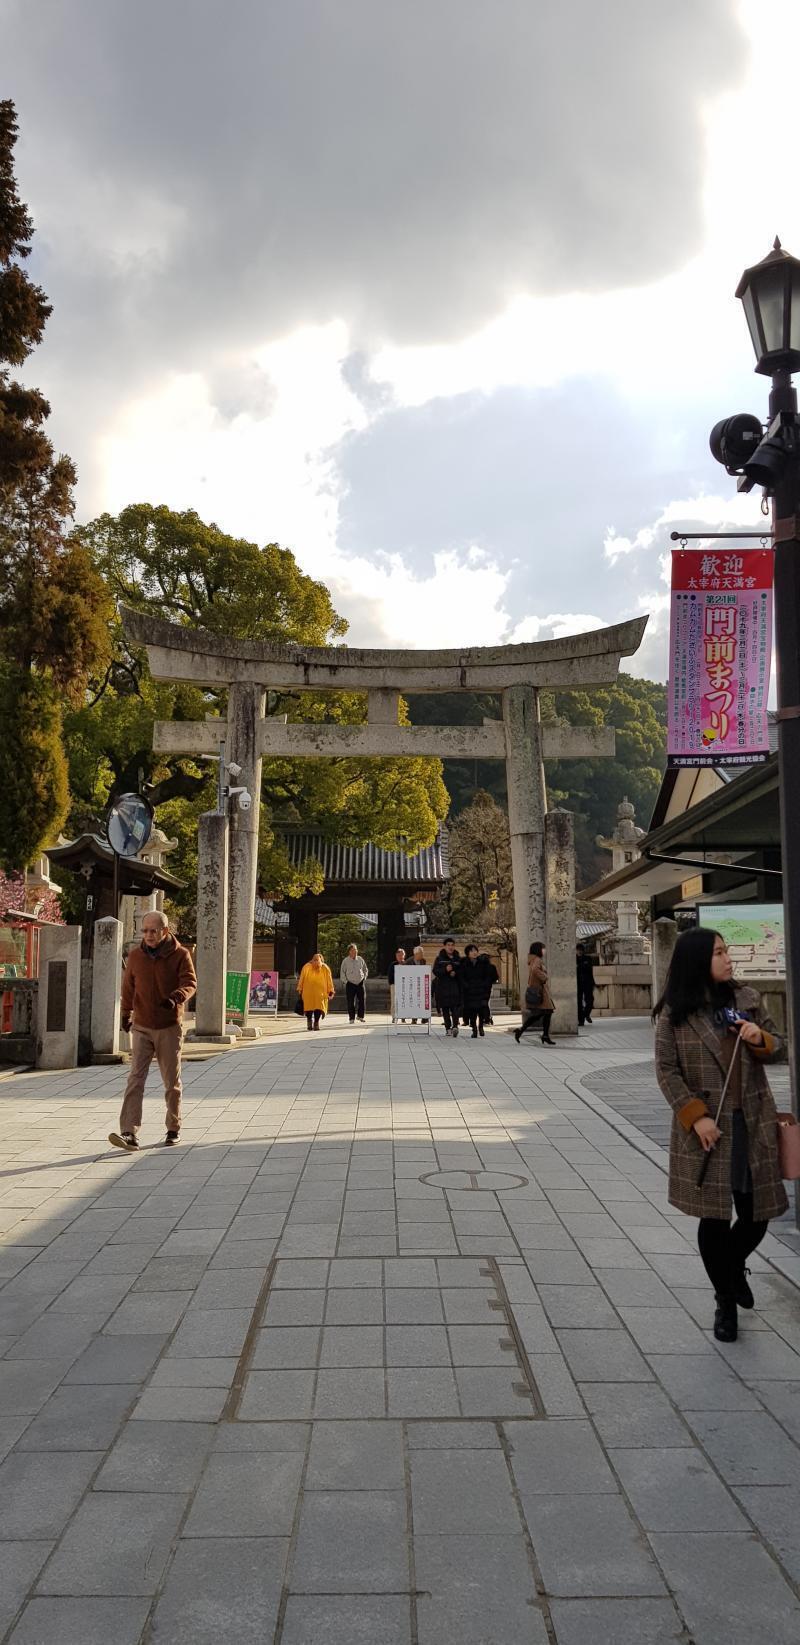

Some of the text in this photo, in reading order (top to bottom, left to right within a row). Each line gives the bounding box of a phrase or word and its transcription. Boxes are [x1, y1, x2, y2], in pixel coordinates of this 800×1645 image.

[687, 576, 757, 589] 太宰府天満宮
[705, 594, 736, 605] 第21回
[703, 606, 737, 742] 門前まつり
